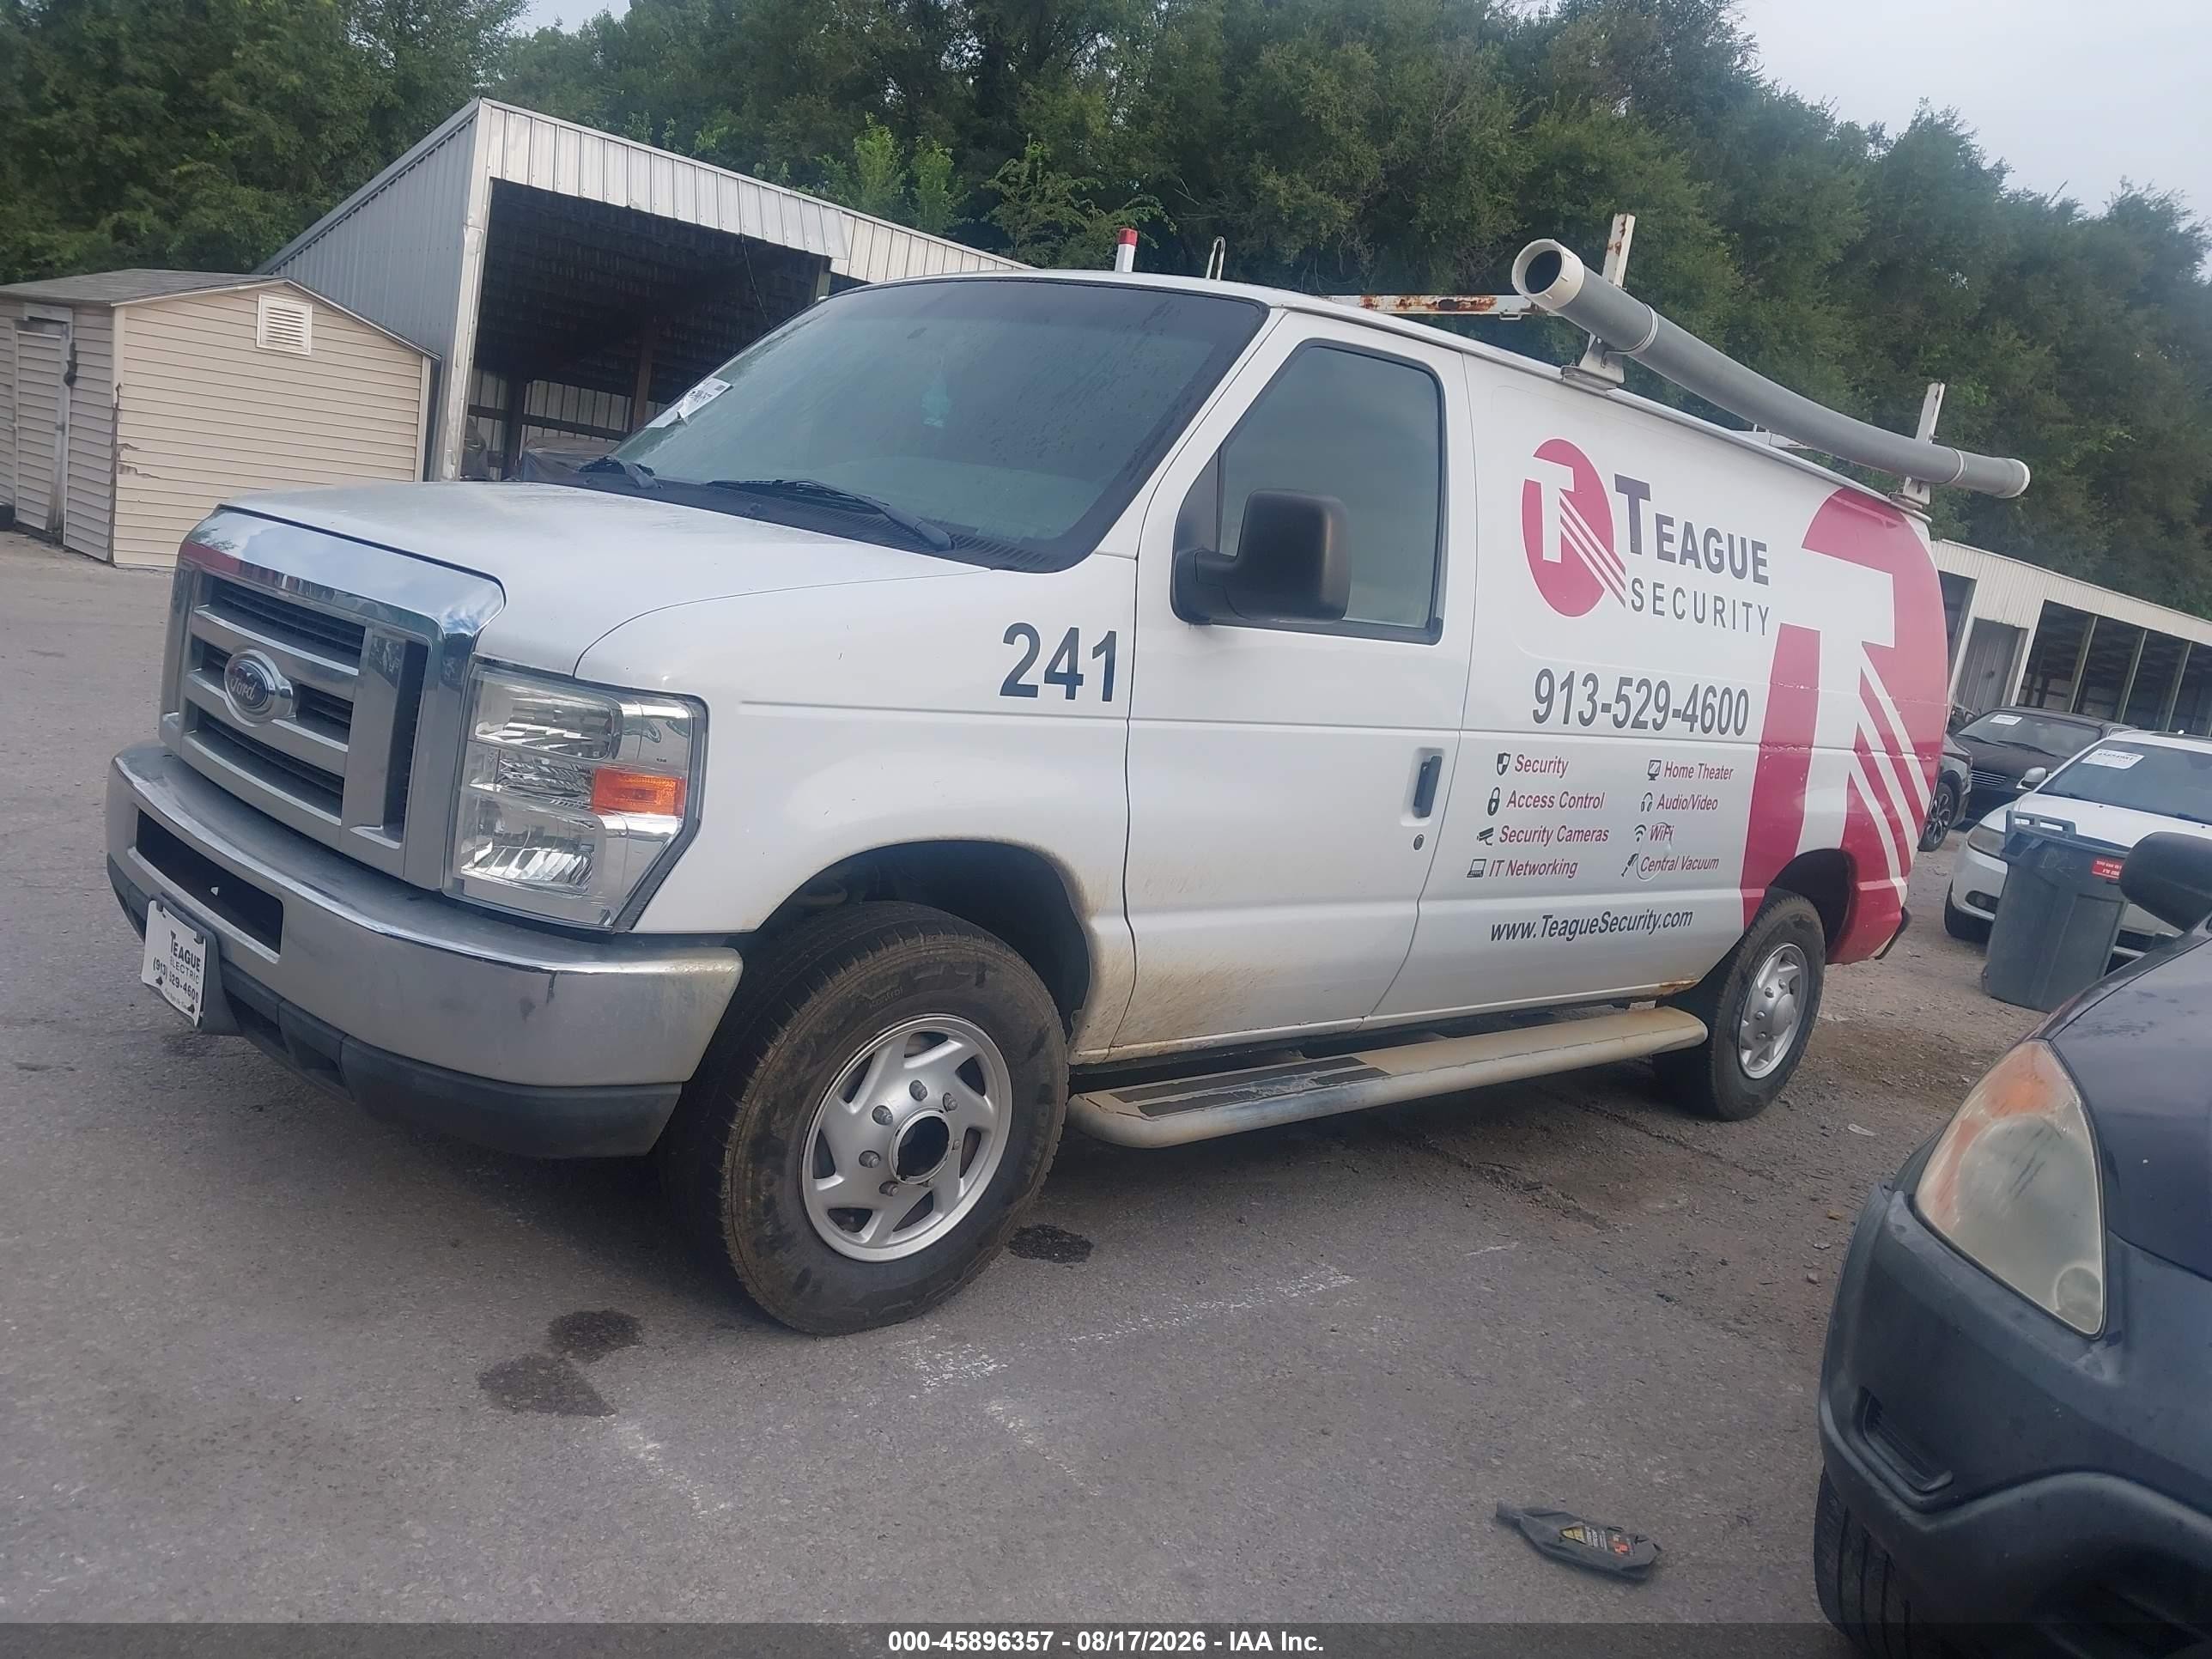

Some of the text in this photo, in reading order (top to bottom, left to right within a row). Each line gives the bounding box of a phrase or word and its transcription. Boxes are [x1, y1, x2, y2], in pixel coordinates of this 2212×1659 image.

[1613, 473, 1770, 586] TEAGUE
[1631, 577, 1771, 636] SECURITY
[1000, 622, 1117, 702] 241
[1532, 668, 1750, 736] 913-529-4600
[1515, 754, 1569, 778] Security
[1664, 761, 1734, 781] Home Theater
[1506, 790, 1605, 809] Access Control
[1656, 793, 1718, 811] Audio/Video
[1499, 825, 1609, 847] Security Cameras
[1489, 859, 1578, 878] IT Networking
[1640, 855, 1719, 872] Central Vacuum
[1491, 908, 1693, 942] www.TeagueSecurity.com
[170, 930, 201, 973] TEAGUE
